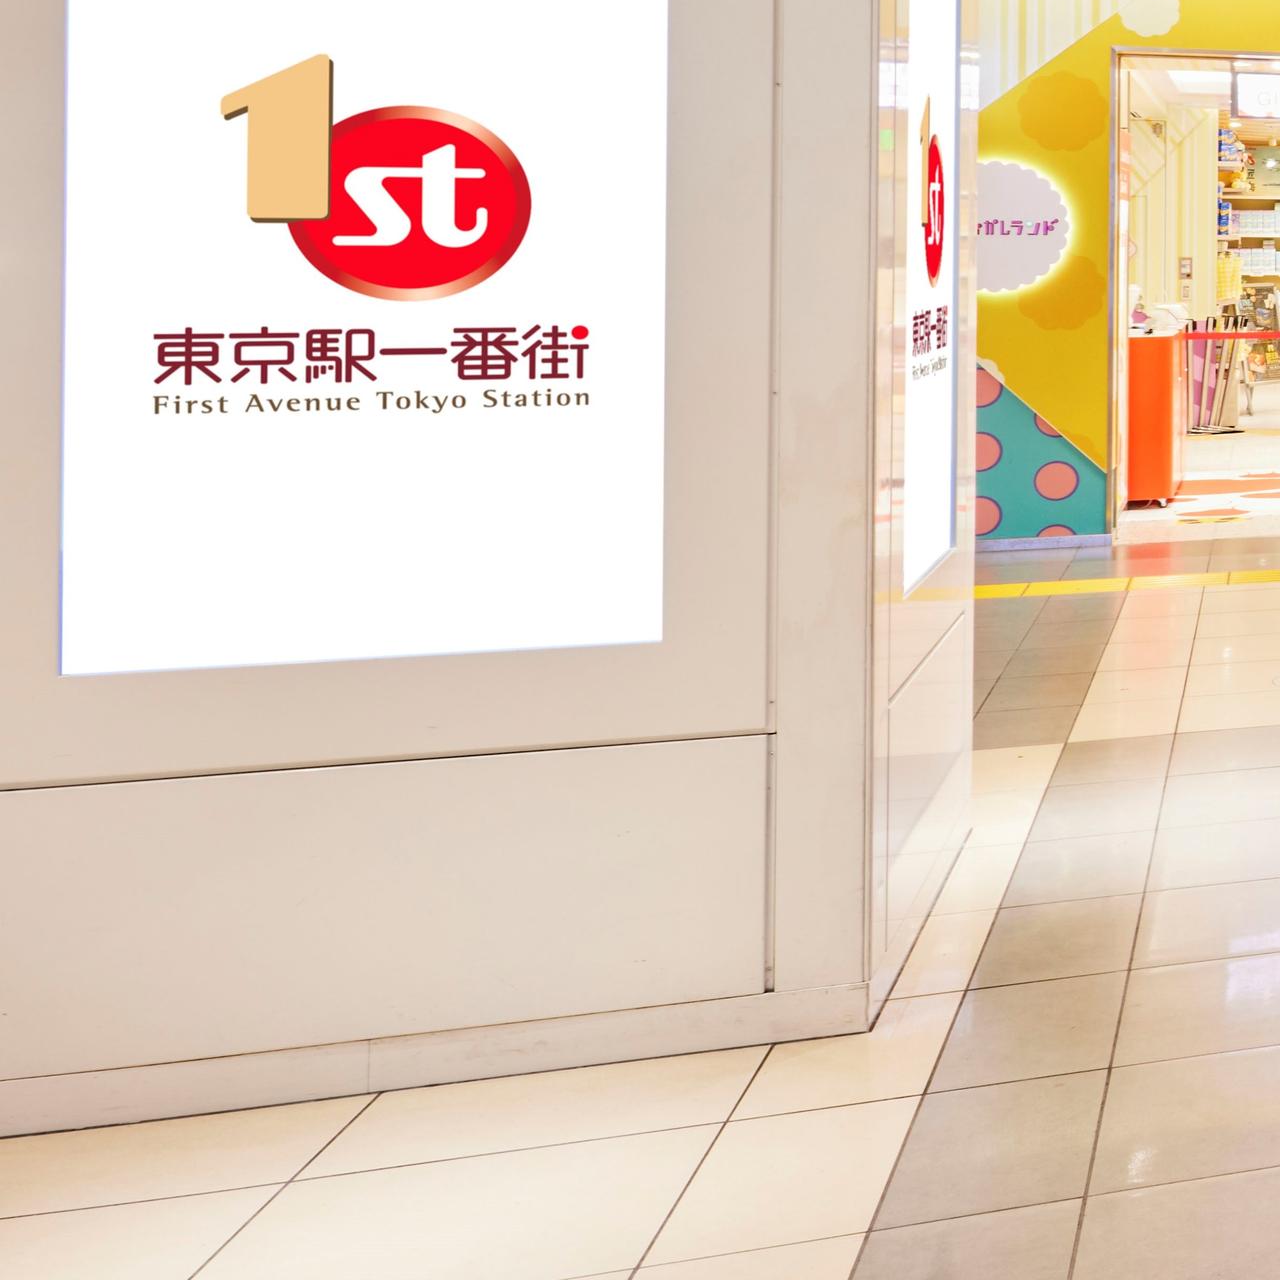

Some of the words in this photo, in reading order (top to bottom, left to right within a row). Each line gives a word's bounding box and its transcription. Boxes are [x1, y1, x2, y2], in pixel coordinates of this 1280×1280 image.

[220, 53, 489, 248] 1st
[153, 324, 590, 386] 東京駅一番街
[152, 394, 230, 415] First
[245, 393, 361, 413] Avenue
[376, 390, 467, 415] Tokyo
[482, 387, 590, 409] Station
